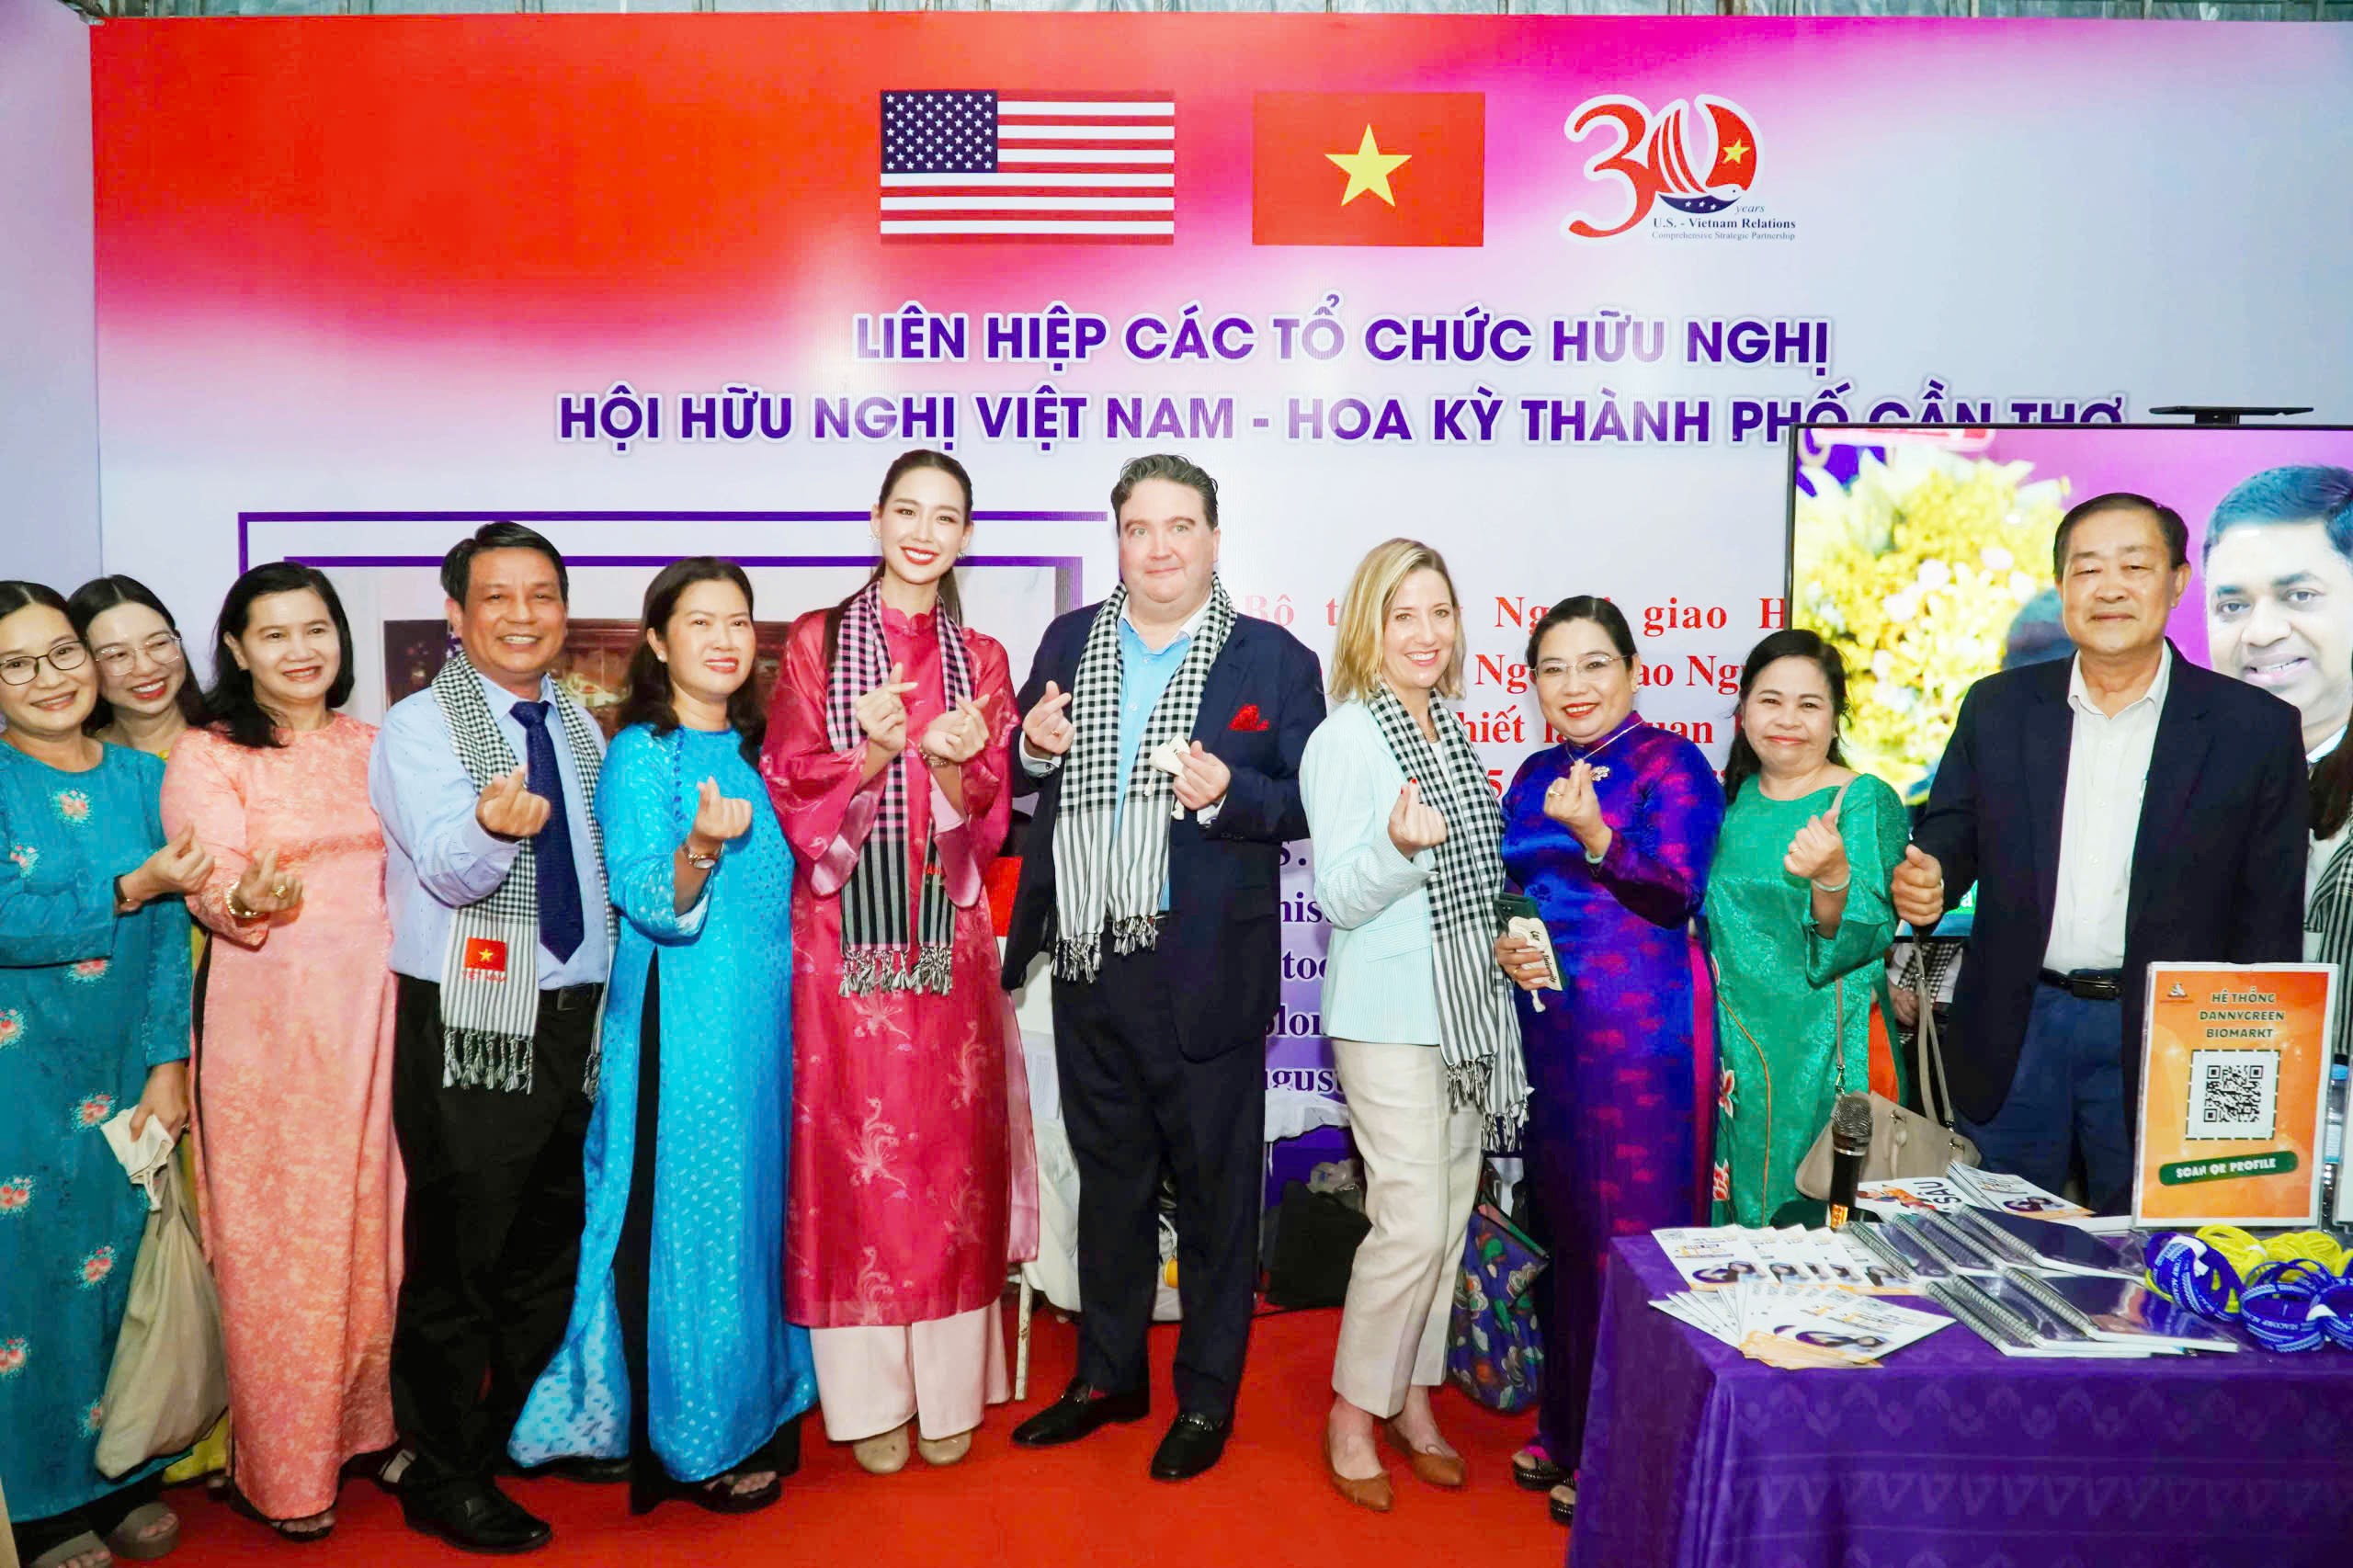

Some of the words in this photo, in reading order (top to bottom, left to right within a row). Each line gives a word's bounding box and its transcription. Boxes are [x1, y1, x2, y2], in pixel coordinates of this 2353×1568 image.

[1733, 203, 1765, 214] years
[1653, 217, 1677, 229] U.S.
[1688, 217, 1740, 229] Vietnam
[1742, 217, 1797, 229] Relations
[1651, 230, 1713, 241] Comprehensive
[1714, 230, 1749, 242] Strategic
[1751, 230, 1796, 242] Partnership
[857, 304, 965, 359] LIÊN
[987, 304, 1106, 371] HIỆP
[1125, 304, 1256, 360] CÁC
[1273, 293, 1346, 361] TỔ
[1365, 304, 1532, 362] CHỨC
[1552, 310, 1665, 363] HỮU
[1687, 321, 1827, 377] NGHỊ
[560, 384, 660, 451] HỘI
[681, 387, 792, 439] HỮU
[813, 396, 954, 451] NGHỊ
[975, 384, 1087, 451] VIỆT
[1107, 396, 1233, 439] NAM
[1289, 396, 1413, 441] HOA
[1433, 385, 1504, 442] KỲ
[1521, 386, 1710, 442] THÀNH
[1643, 597, 1728, 638] giao
[1456, 704, 1526, 744] hiết
[2212, 989, 2229, 1006] HỆ
[2200, 1011, 2285, 1020] DANNYGREEN
[2206, 1028, 2273, 1038] BIOMARKT
[2176, 1165, 2206, 1178] SCAN
[2209, 1163, 2227, 1176] QR
[2230, 1158, 2277, 1173] PROFILE
